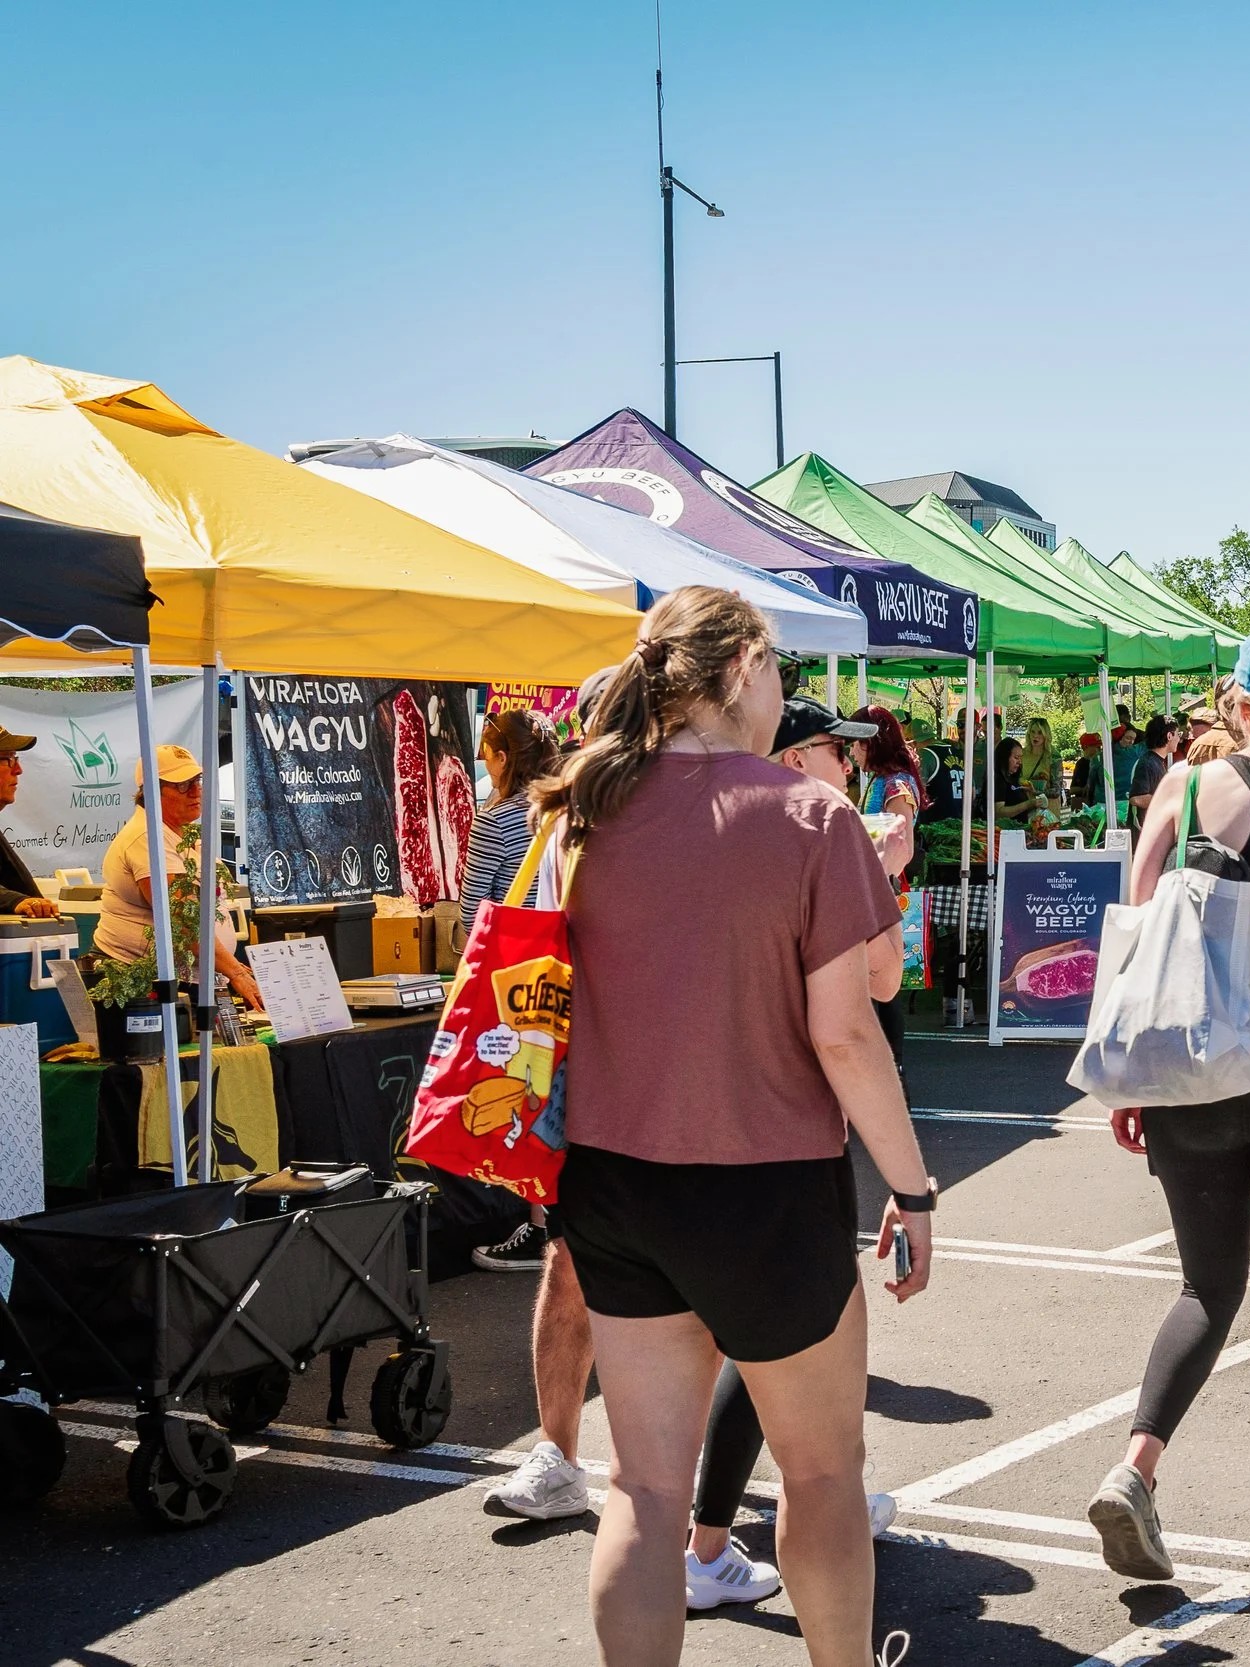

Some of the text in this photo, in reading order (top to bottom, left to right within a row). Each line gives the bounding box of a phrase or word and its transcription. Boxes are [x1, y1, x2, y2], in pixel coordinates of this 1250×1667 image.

[875, 581, 949, 629] WAGYU BEEF
[254, 712, 368, 753] WAGYU
[317, 764, 362, 786] Colorado
[69, 790, 121, 809] Microvora
[53, 824, 68, 849] &
[1050, 883, 1073, 891] wagyu
[1025, 891, 1096, 905] Premium Colorado
[1025, 904, 1097, 915] WAGYU
[1035, 916, 1087, 927] BEEF
